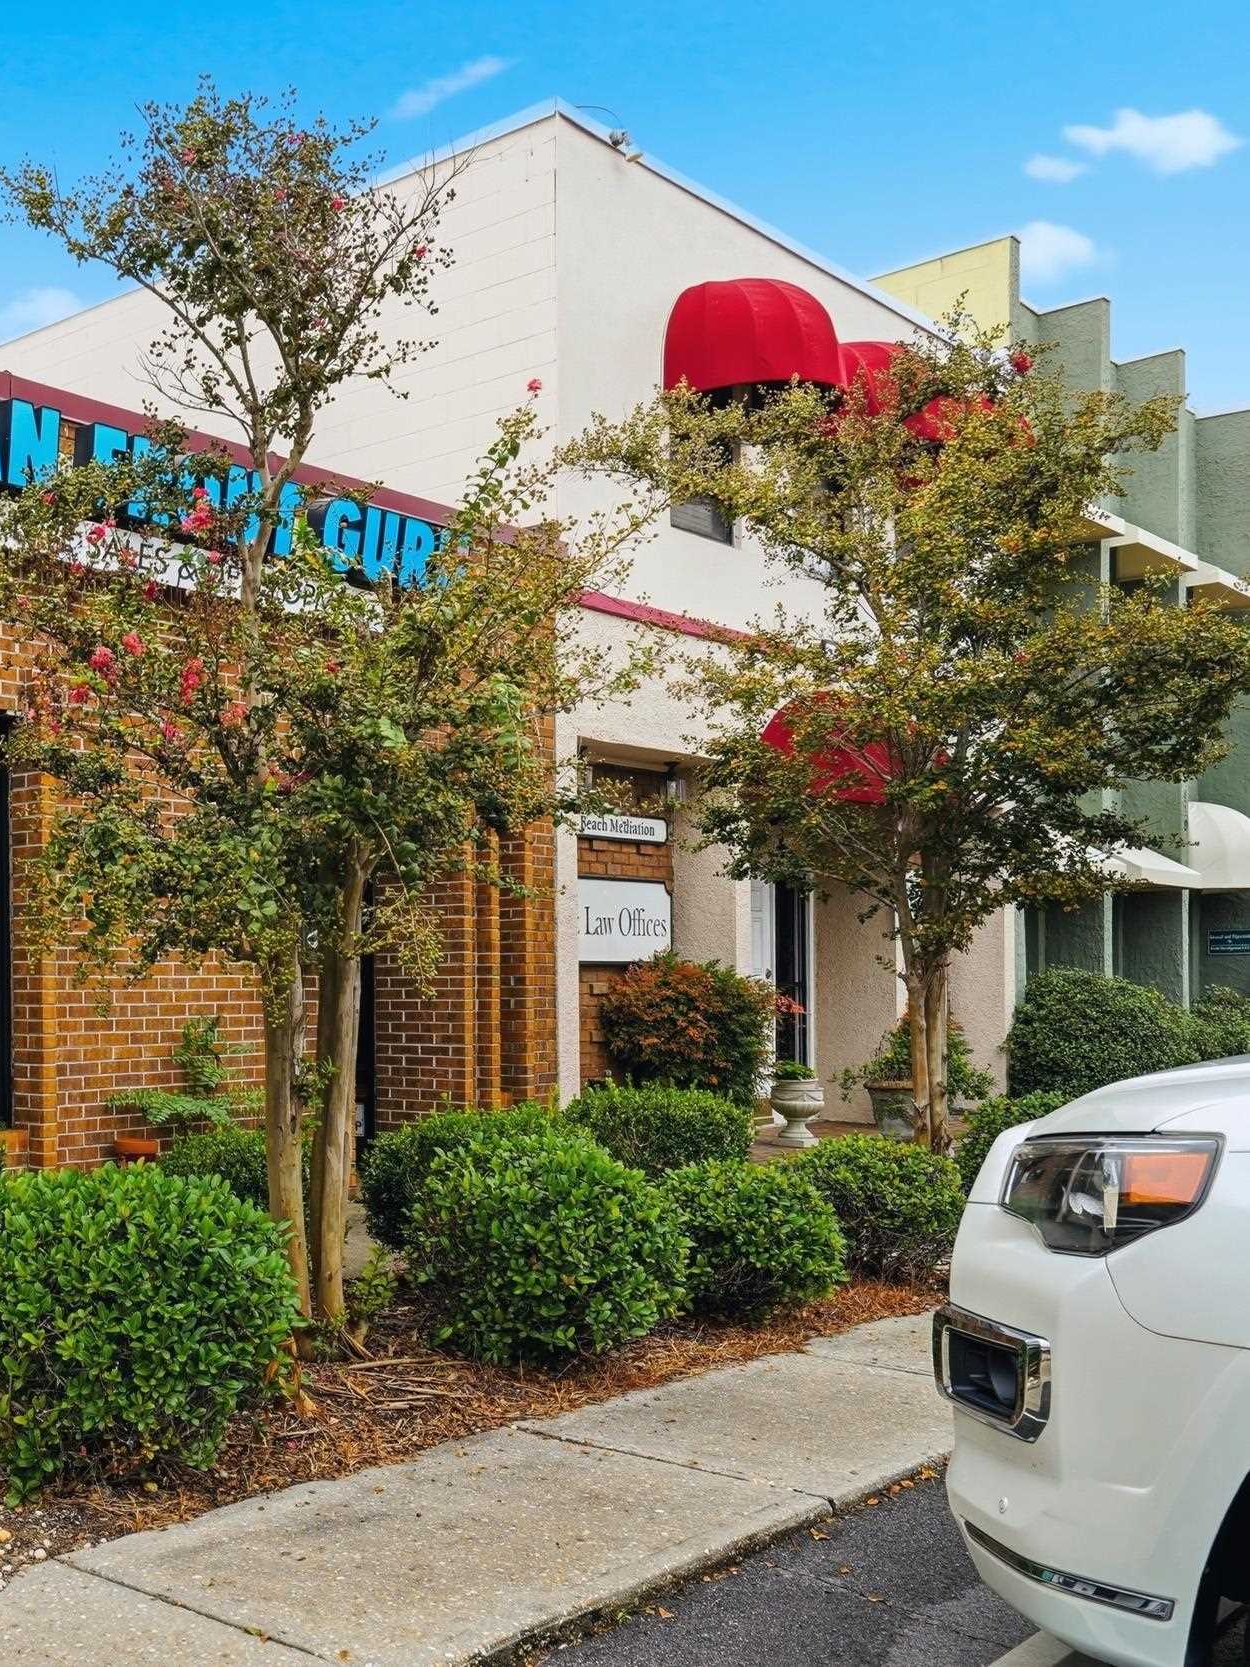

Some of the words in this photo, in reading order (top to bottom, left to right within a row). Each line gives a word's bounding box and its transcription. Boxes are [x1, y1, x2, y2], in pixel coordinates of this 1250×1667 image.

[580, 815, 608, 832] Beach
[609, 818, 655, 836] Mediation
[584, 906, 614, 935] Law
[619, 907, 667, 937] Offices
